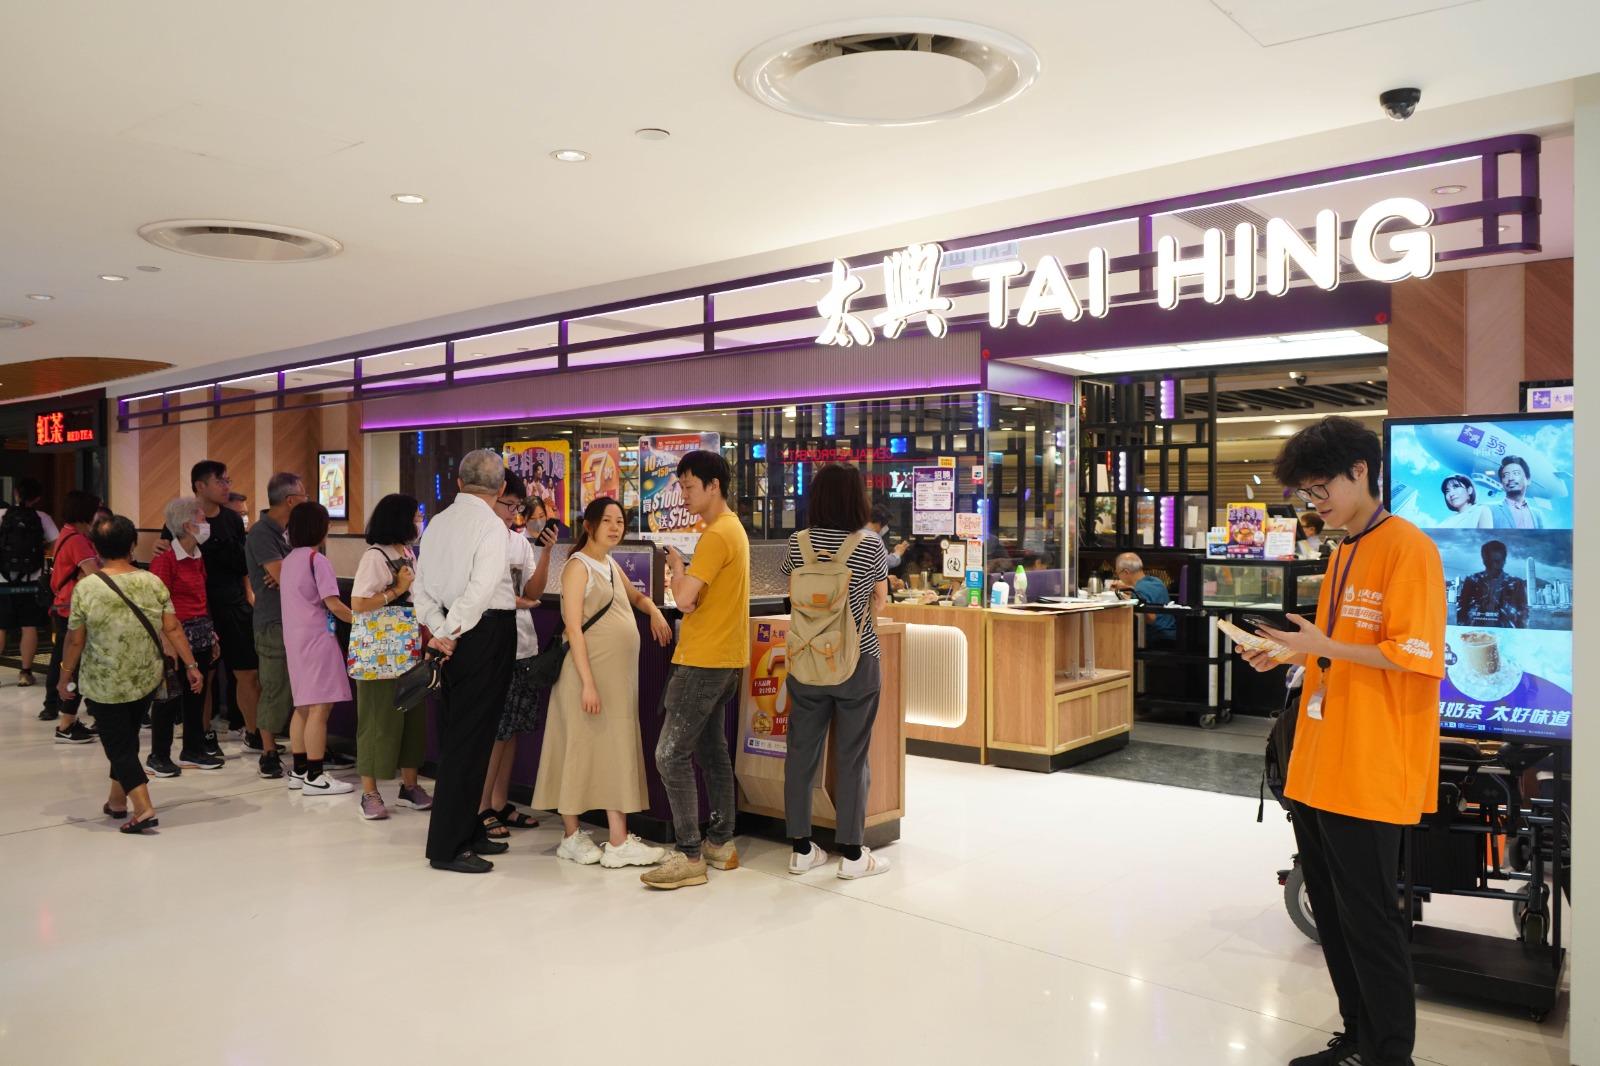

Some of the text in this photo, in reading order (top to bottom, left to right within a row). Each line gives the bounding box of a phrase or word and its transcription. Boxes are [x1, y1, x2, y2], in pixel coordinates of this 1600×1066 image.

[972, 197, 1435, 329] TAI HING
[815, 242, 954, 347] 太興
[36, 411, 64, 445] 紅茶
[66, 429, 93, 441] RED TEA
[1486, 435, 1507, 456] 33
[1486, 705, 1571, 727] 太好味道
